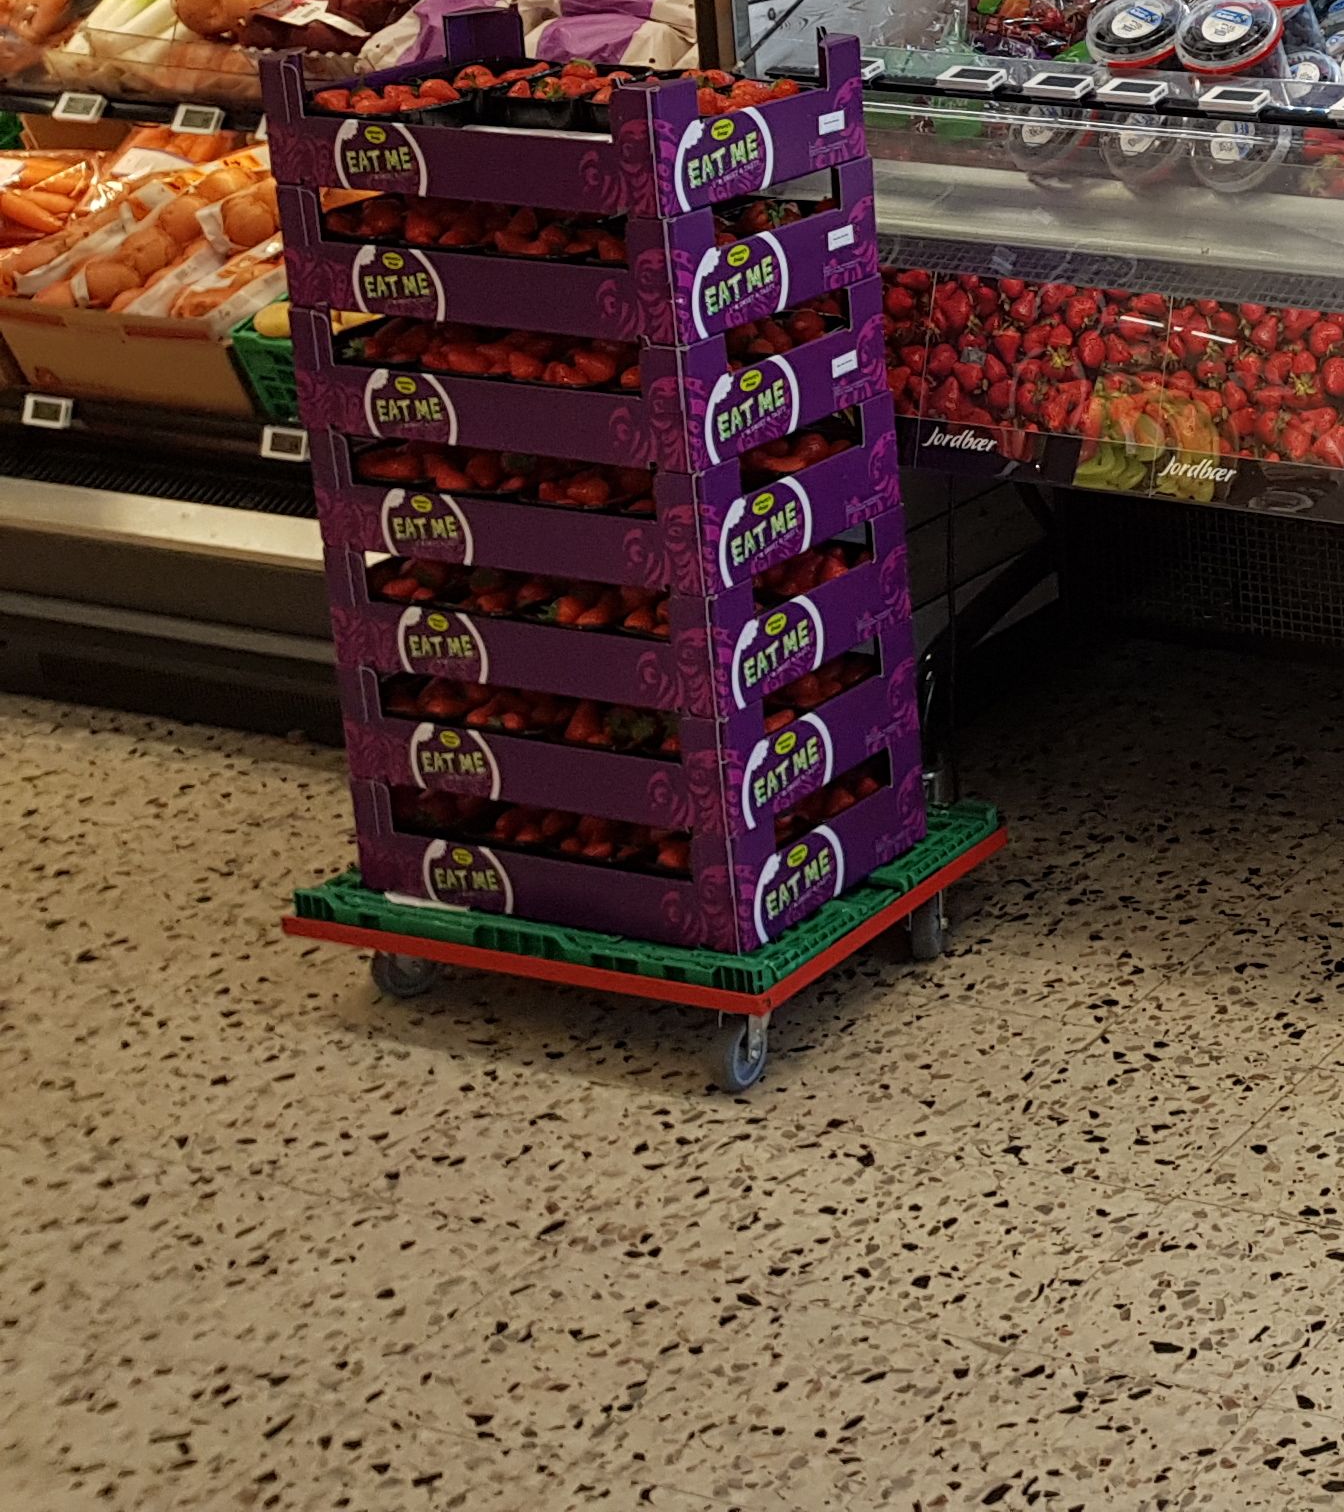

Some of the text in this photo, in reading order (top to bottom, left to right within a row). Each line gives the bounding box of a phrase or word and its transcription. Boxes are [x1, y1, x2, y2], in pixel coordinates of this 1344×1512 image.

[346, 147, 412, 174] EAT ME
[687, 131, 759, 189] EAT ME
[364, 272, 430, 298] EAT ME
[704, 272, 742, 316] EAT
[746, 255, 775, 293] ME
[376, 396, 442, 423] EAT ME
[717, 378, 785, 442] EAT ME
[923, 426, 998, 453] Jordbær
[1160, 455, 1237, 483] Jordbær
[392, 515, 459, 541] EAT ME
[730, 500, 798, 566] EAT ME
[409, 635, 474, 658] EAT ME
[743, 618, 810, 688] EAT ME
[421, 751, 486, 774] EAT ME
[753, 736, 820, 808] EAT ME
[433, 868, 498, 891] EAT ME
[765, 847, 831, 920] EAT ME
